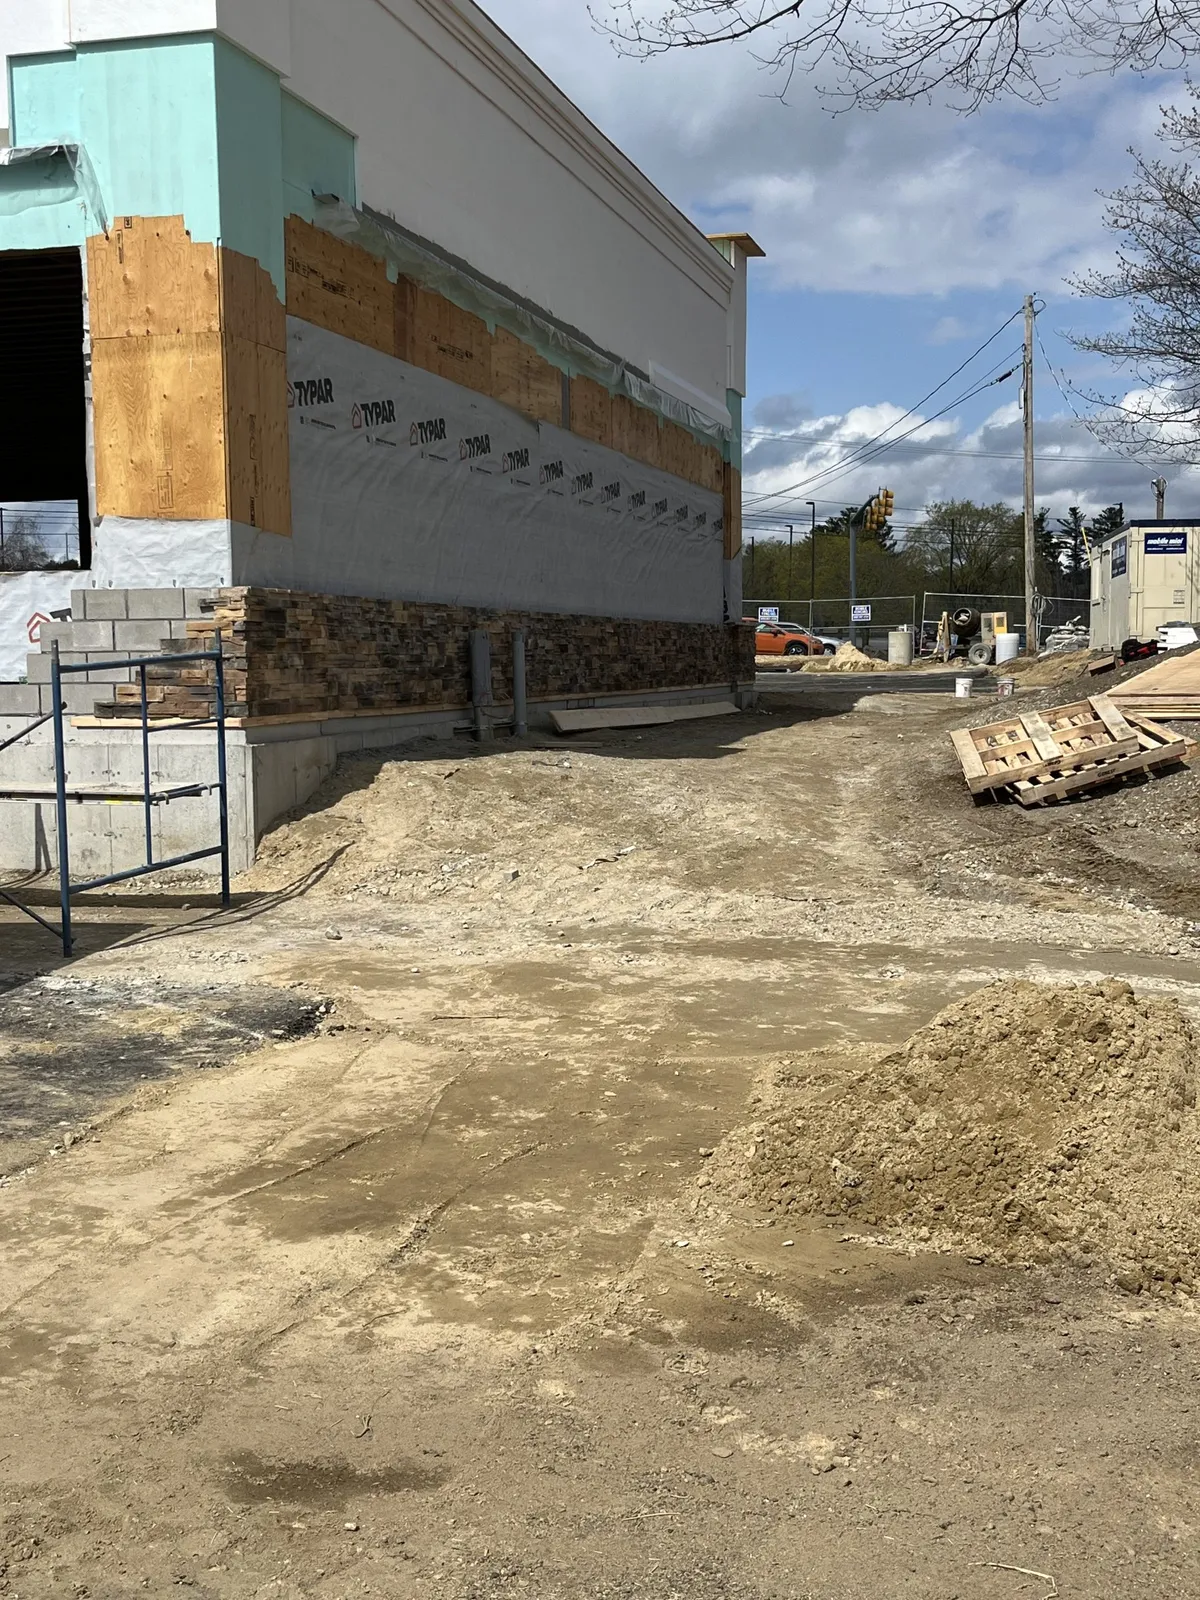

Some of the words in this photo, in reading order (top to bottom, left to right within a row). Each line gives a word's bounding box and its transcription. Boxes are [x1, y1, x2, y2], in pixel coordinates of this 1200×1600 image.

[294, 378, 334, 407] TYPAR
[360, 400, 396, 427] TYPAR
[418, 418, 447, 444] TYPAR
[465, 434, 491, 458] TYPAR
[508, 448, 530, 471] TYPAR
[544, 460, 564, 483] TYPAR
